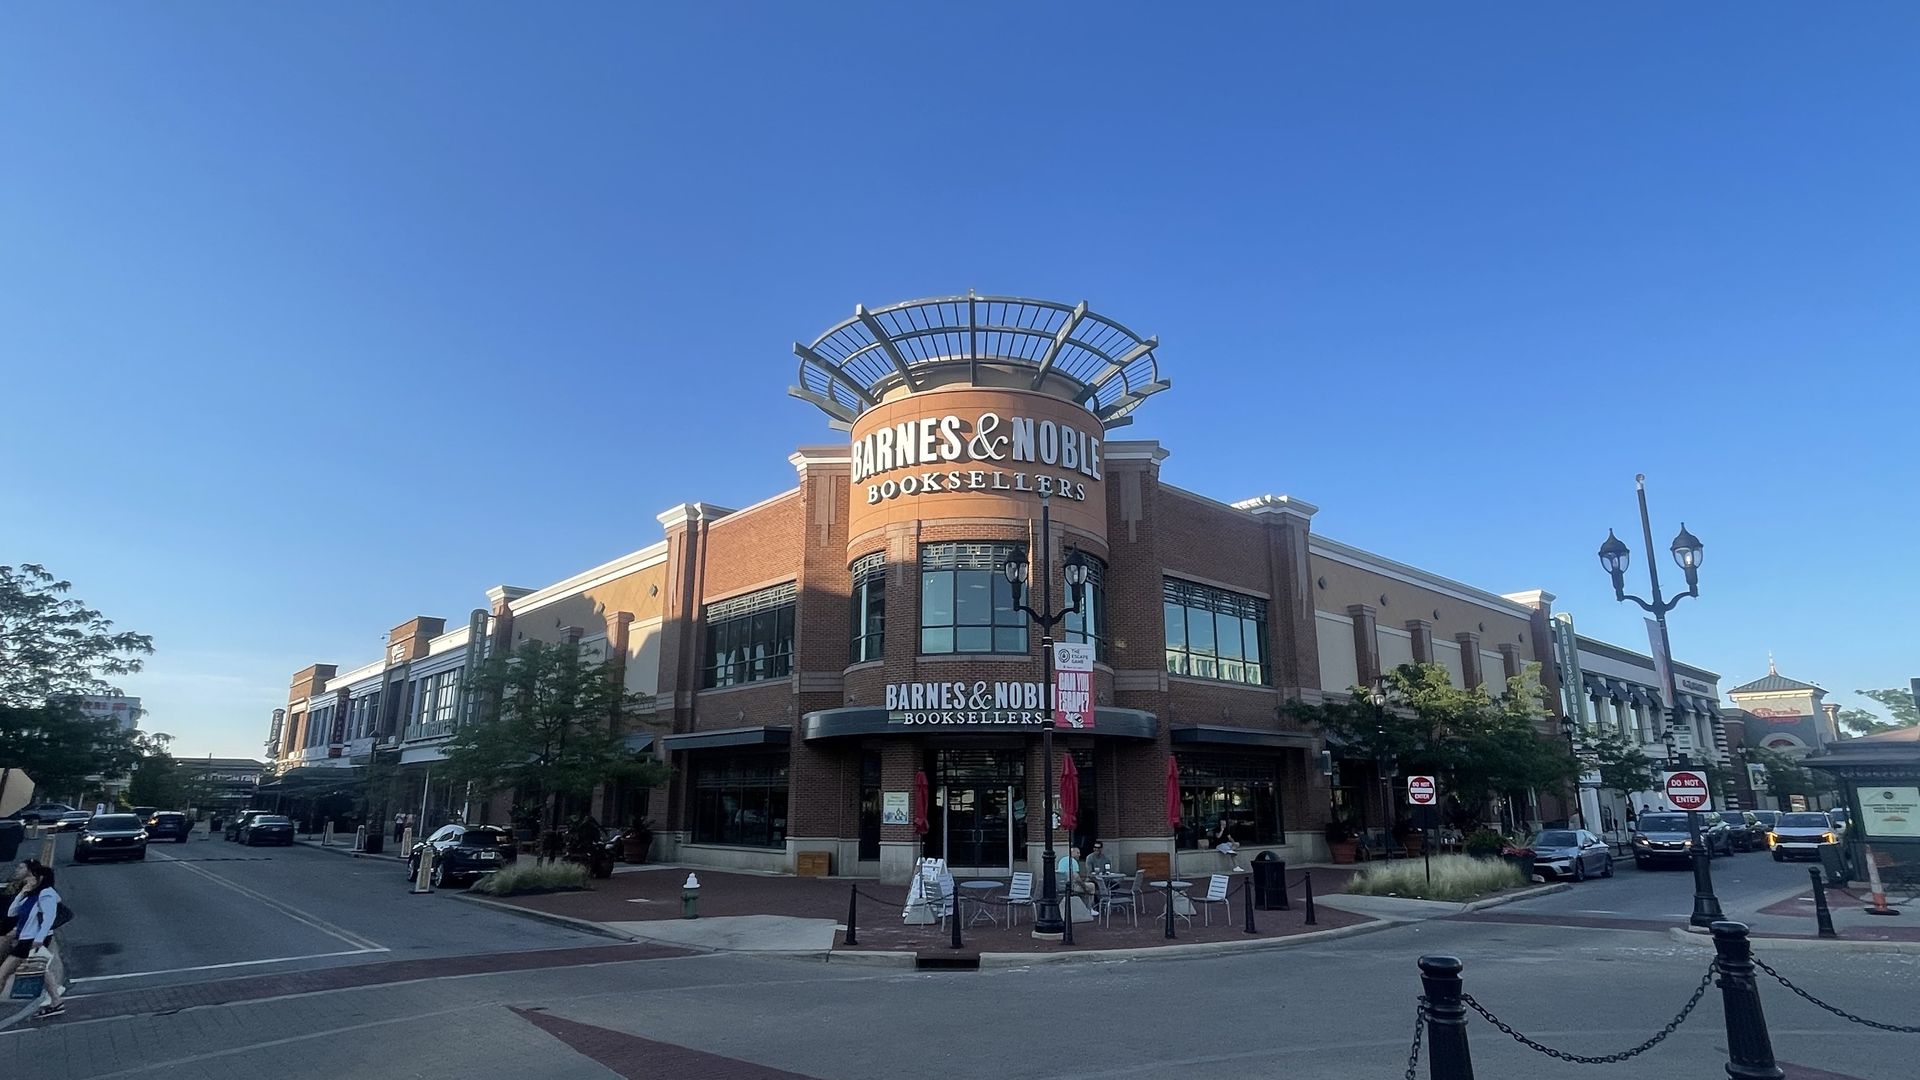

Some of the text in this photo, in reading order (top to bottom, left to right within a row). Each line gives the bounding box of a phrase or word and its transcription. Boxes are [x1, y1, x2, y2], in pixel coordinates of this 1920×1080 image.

[853, 412, 1101, 483] BARNES & NOBLE
[867, 470, 1085, 504] BOOKSELLERS
[886, 682, 966, 710] BARNES
[969, 681, 992, 710] &
[903, 711, 1043, 725] BOOKSELLERS
